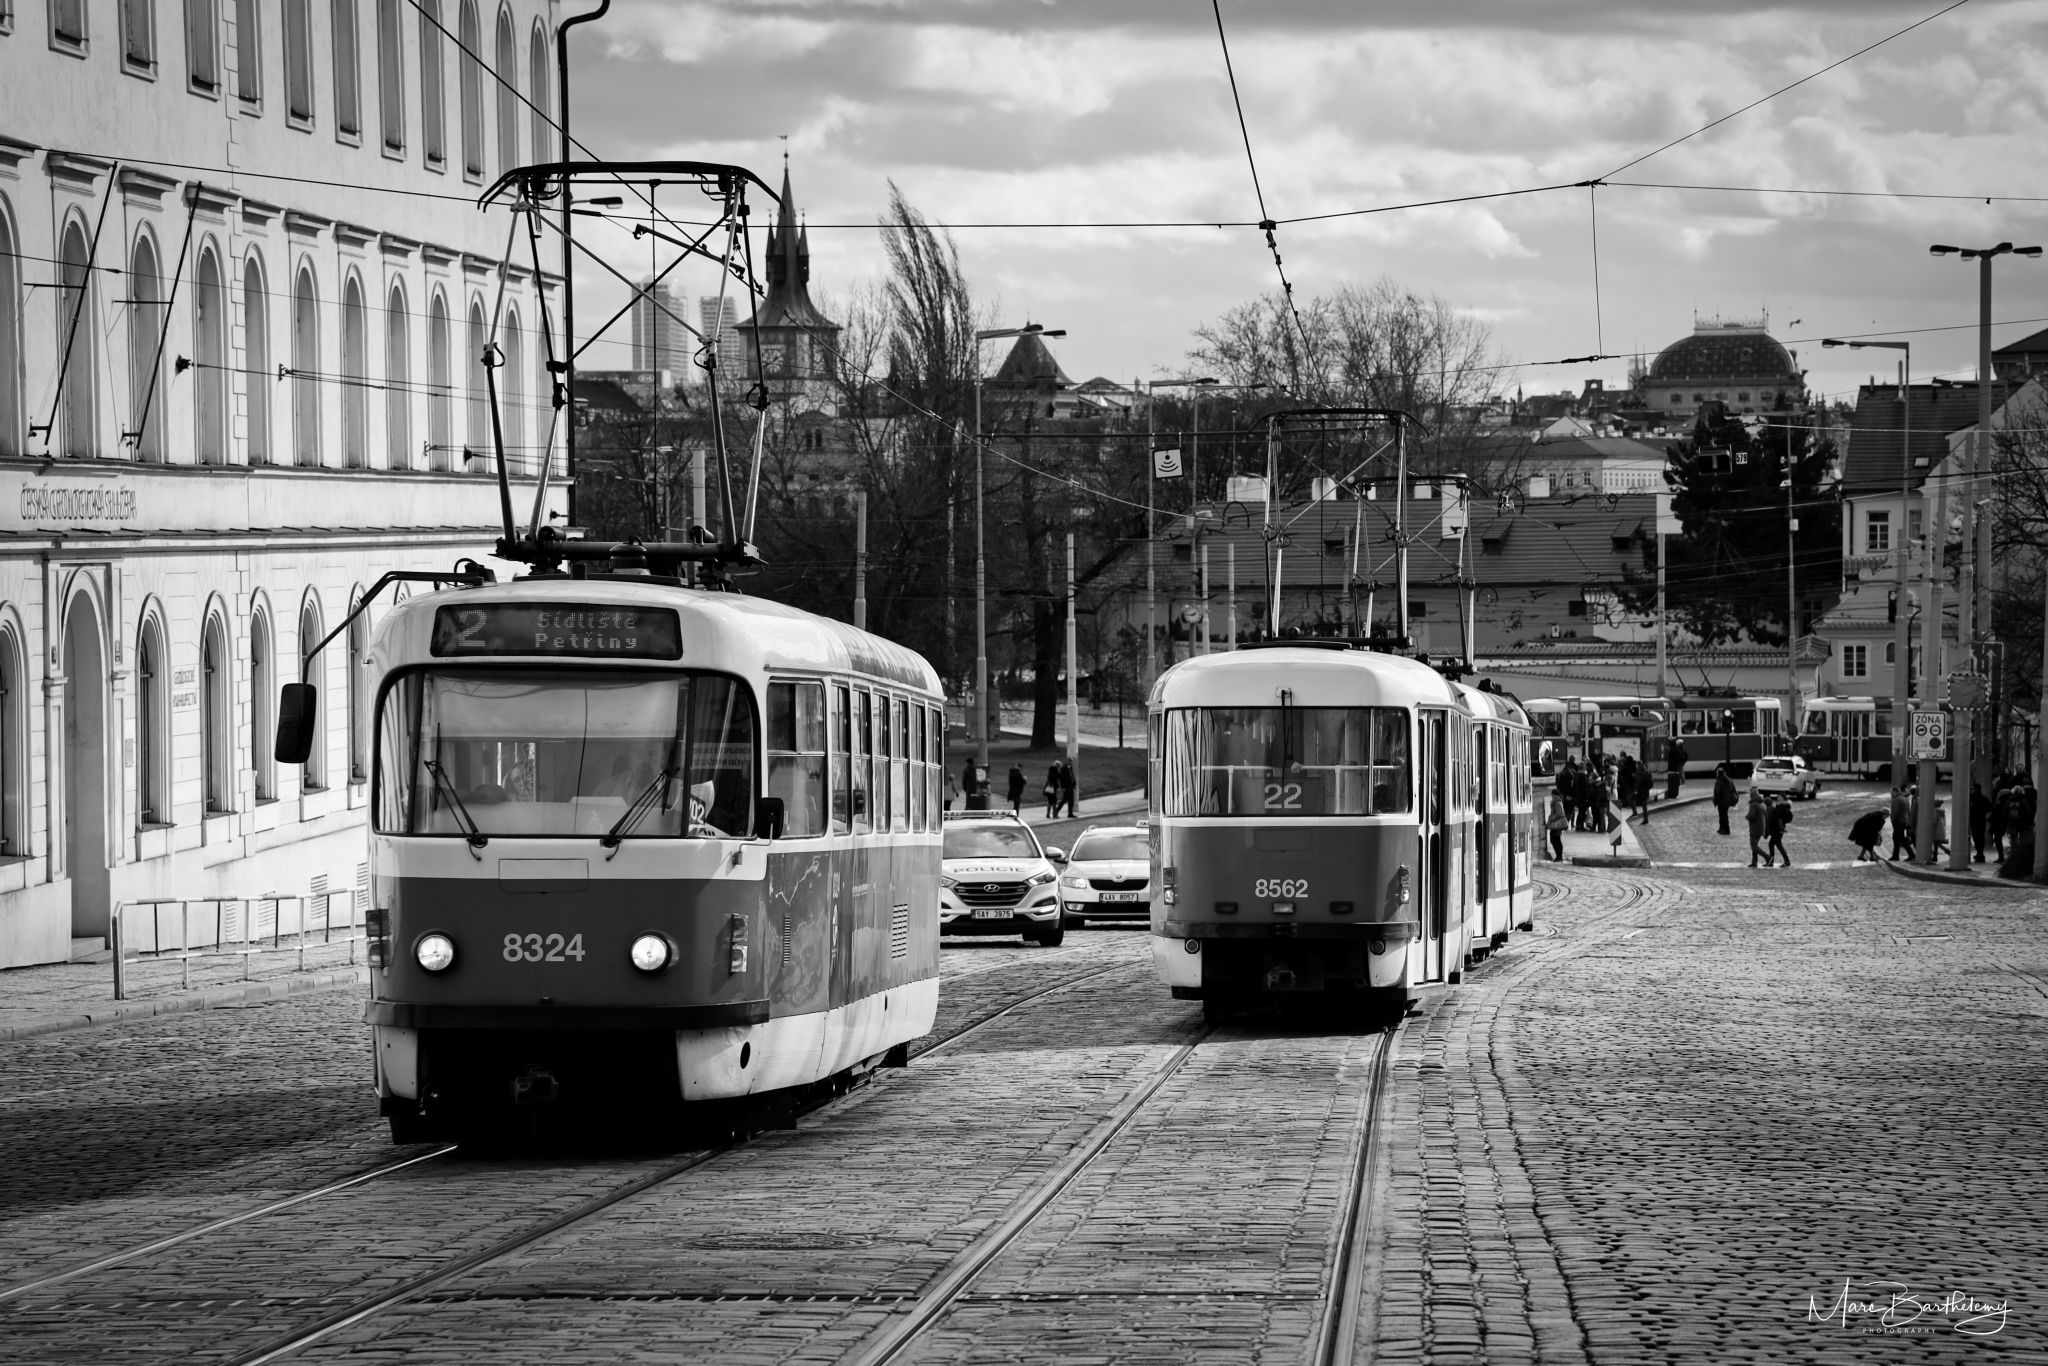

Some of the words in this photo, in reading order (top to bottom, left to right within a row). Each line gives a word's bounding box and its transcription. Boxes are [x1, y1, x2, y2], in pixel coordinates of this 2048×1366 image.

[458, 609, 488, 647] 2
[534, 631, 638, 650] Petřiny
[1915, 713, 1941, 724] ZÓNA
[1264, 783, 1302, 809] 22
[1254, 878, 1309, 898] 8562
[976, 910, 990, 918] 5AY
[502, 933, 586, 962] 8324
